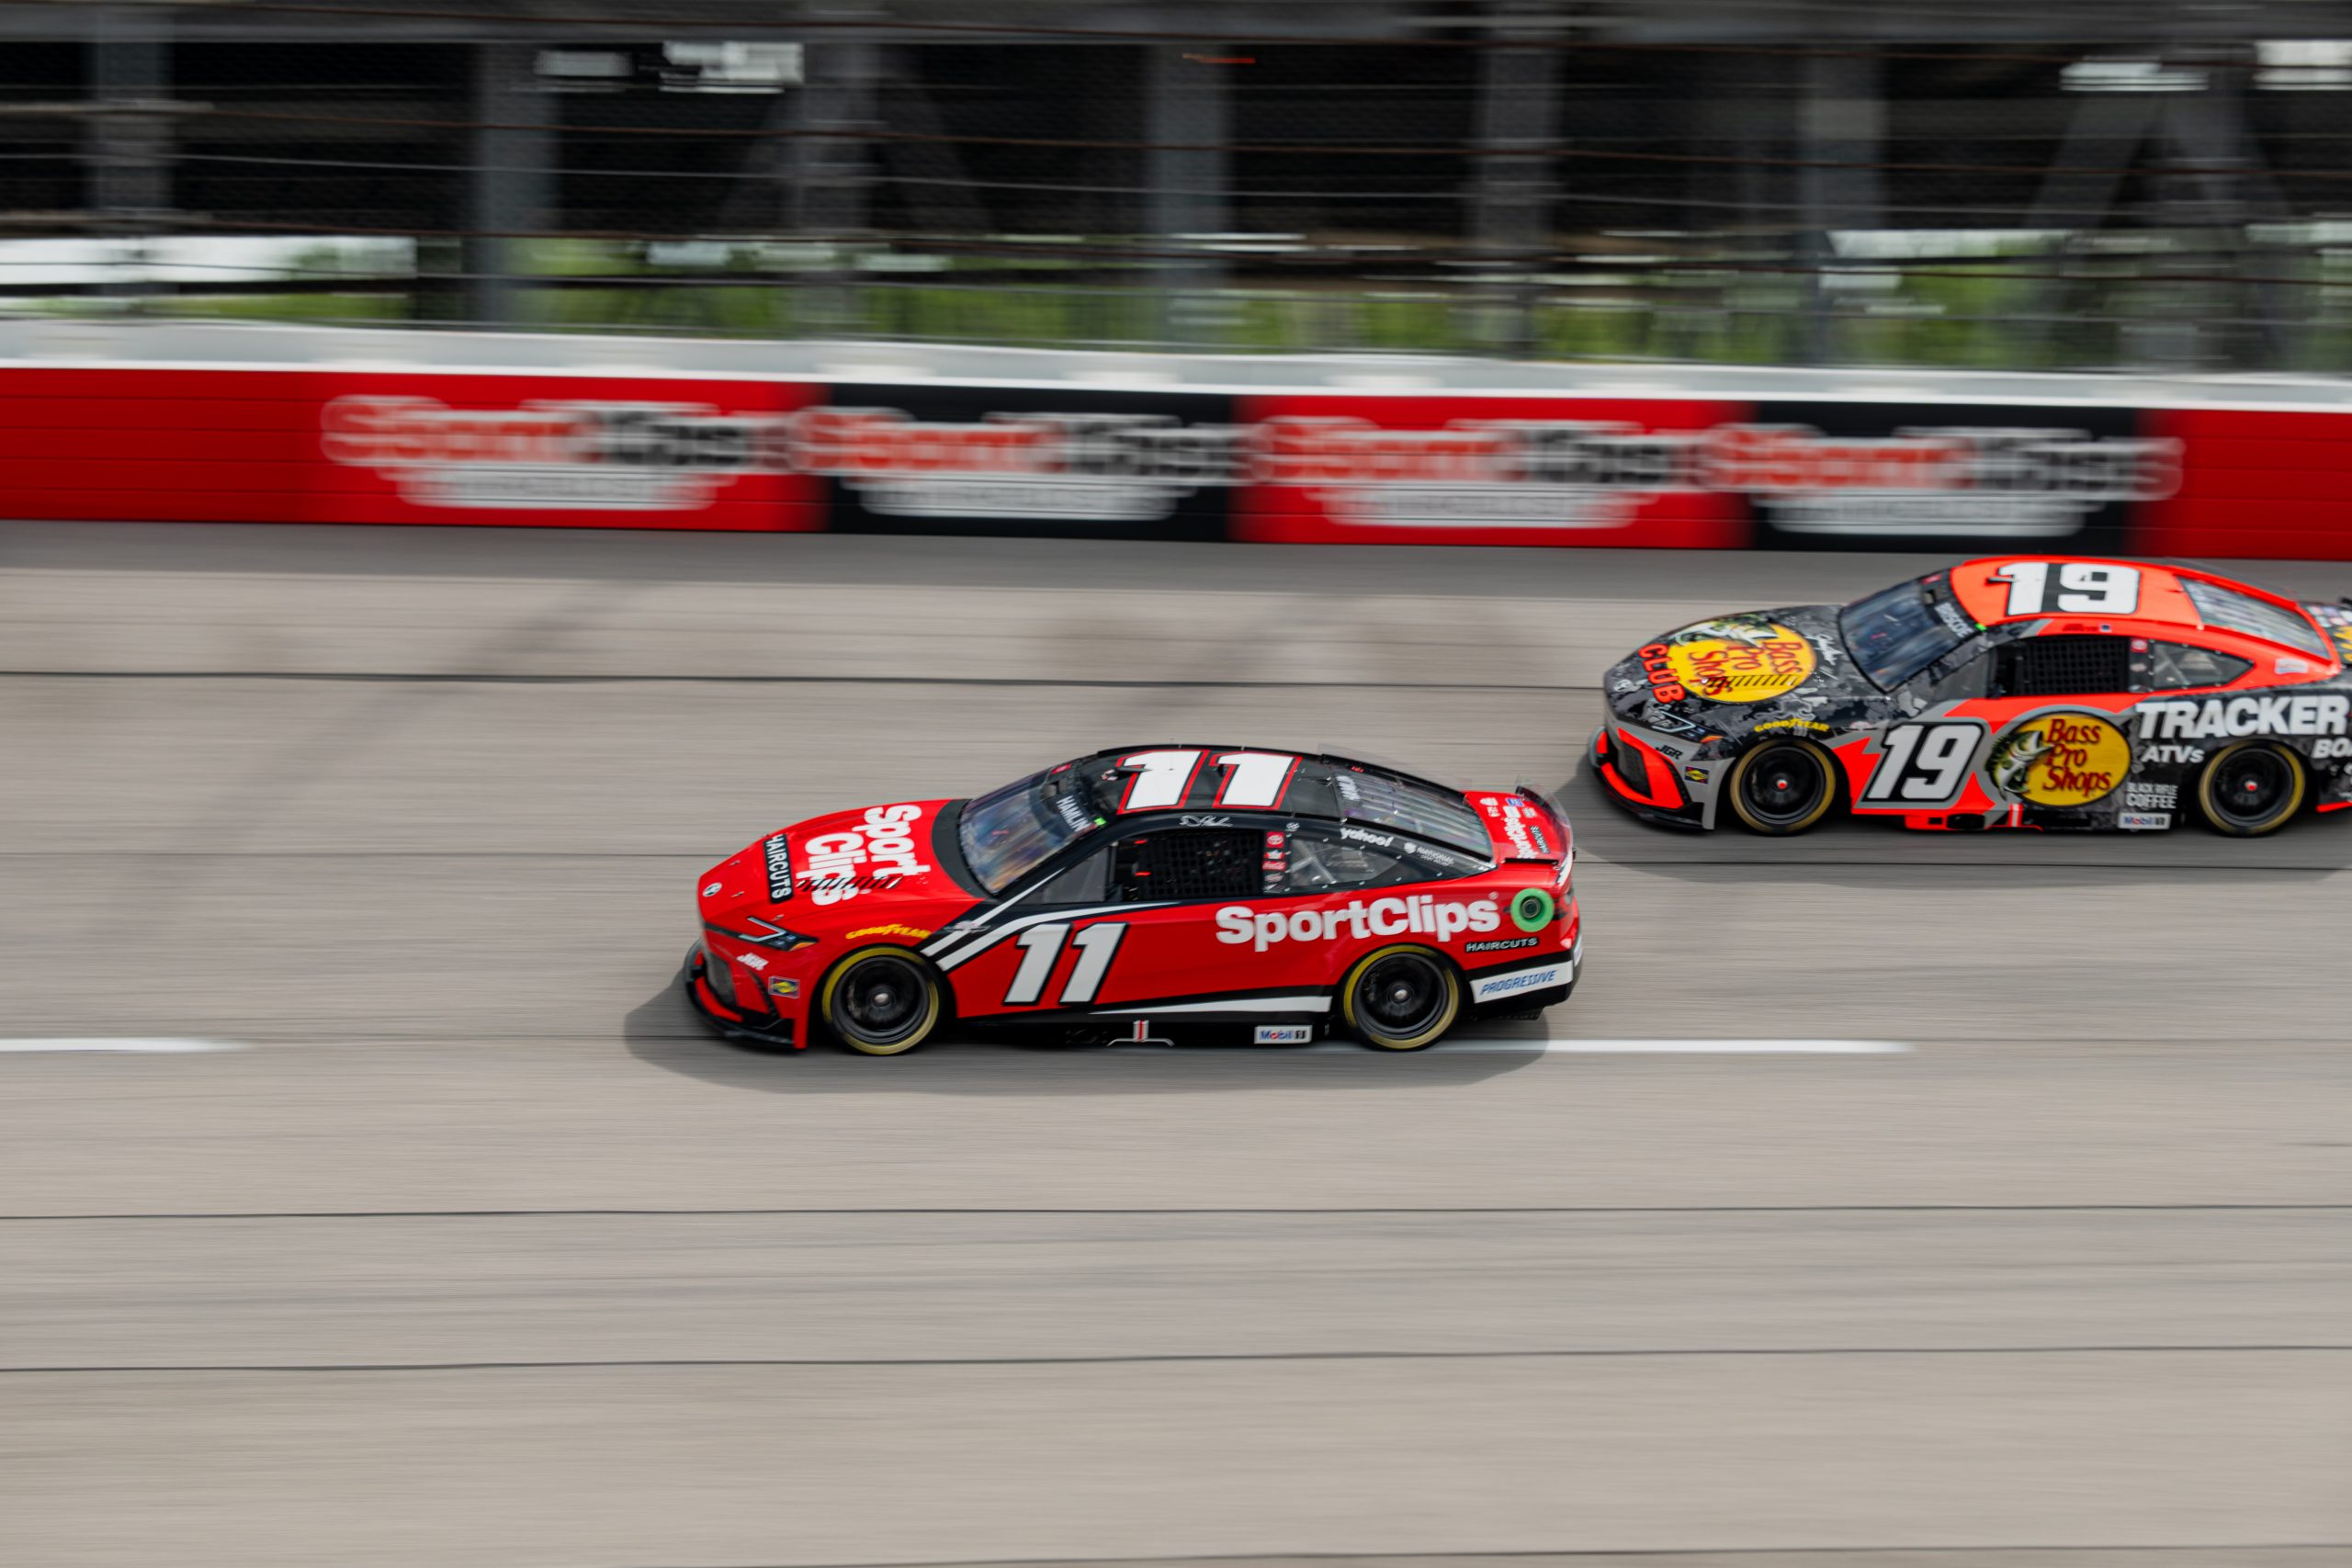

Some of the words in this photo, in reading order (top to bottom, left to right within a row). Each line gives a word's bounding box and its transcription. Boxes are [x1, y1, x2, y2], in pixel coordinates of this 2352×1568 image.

[1998, 562, 2141, 615] 19
[1724, 646, 1765, 671] Pro
[1759, 640, 1805, 674] Bass
[1638, 643, 1686, 704] CLUB
[1754, 717, 1830, 733] GOODYEAR
[2135, 694, 2350, 739] TRACKER
[2044, 718, 2102, 745] Bass
[1656, 745, 1683, 761] JGR
[1866, 724, 1983, 800] 19
[2044, 743, 2087, 767] Pro
[2140, 745, 2205, 763] ATVs
[2311, 737, 2352, 759] BO
[1123, 750, 1295, 810] 11
[2042, 765, 2112, 797] Shops
[1056, 795, 1091, 832] HAMLIN
[2126, 793, 2178, 809] COFFEE
[2123, 816, 2153, 826] Mobil
[852, 805, 931, 880] Sport
[1340, 827, 1395, 847] yahoo!
[765, 834, 792, 899] HAIRCUTS
[796, 832, 868, 906] Clips
[1215, 894, 1501, 953] SportClips
[1465, 937, 1538, 953] HAIRCUTS
[1003, 923, 1127, 1003] 11
[1479, 970, 1557, 996] PROGRESSIVE
[1260, 1030, 1294, 1040] Mobil
